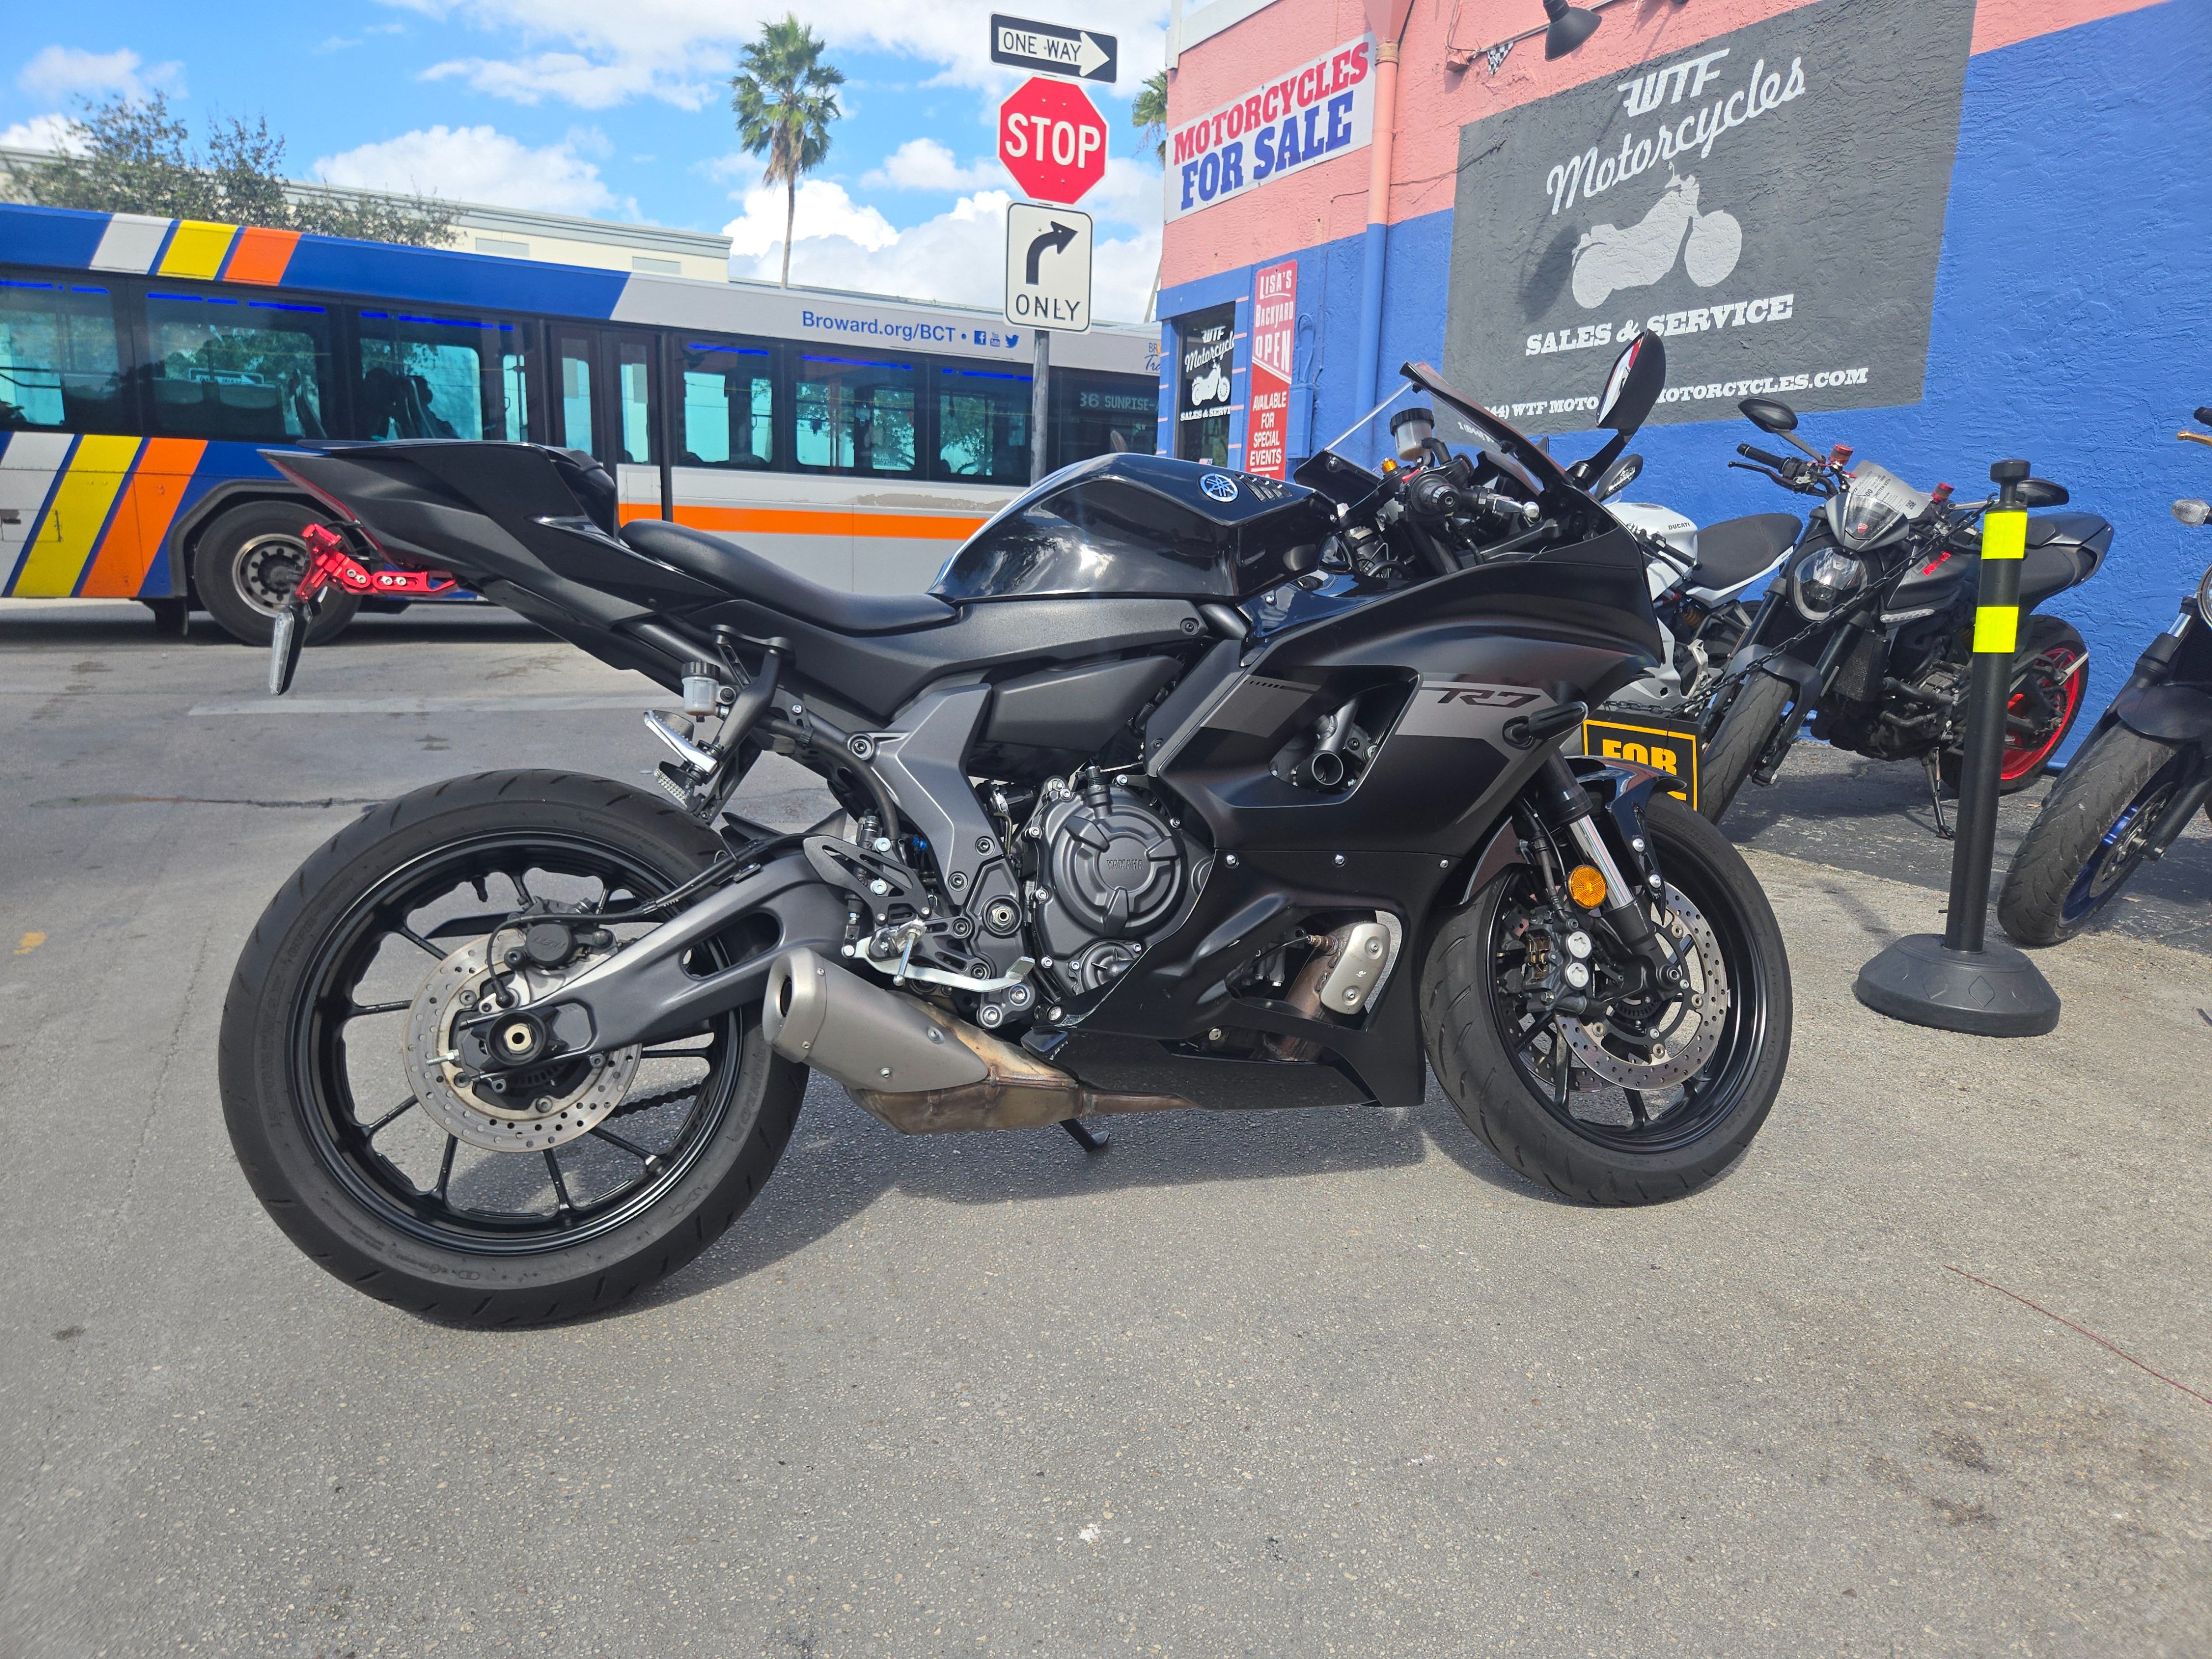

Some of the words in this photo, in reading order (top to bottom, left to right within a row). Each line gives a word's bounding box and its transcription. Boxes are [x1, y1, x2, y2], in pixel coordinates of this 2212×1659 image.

[1003, 32, 1037, 54] ONE
[1047, 39, 1082, 62] WAY
[1618, 47, 1730, 118] WTF
[1173, 41, 1369, 166] MOTORCYCLES
[1005, 112, 1102, 168] STOP
[1546, 56, 1806, 216] Motorcycles
[1181, 141, 1244, 211] FOR
[1253, 90, 1354, 180] SALE
[1259, 269, 1292, 300] LISA'S
[1015, 294, 1081, 321] ONLY
[1255, 301, 1294, 329] BACKYARD
[802, 310, 956, 343] Broward.org/BCT
[1201, 326, 1227, 343] WTF
[1525, 322, 1612, 356] SALES
[1616, 319, 1640, 343] &
[1646, 294, 1794, 337] SERVICE
[1255, 330, 1291, 374] OPEN
[1180, 410, 1202, 421] SALES
[1202, 409, 1209, 418] &
[1253, 392, 1287, 411] AVAILABLE
[1484, 404, 1510, 420] 44)
[1512, 401, 1548, 416] WTF
[1548, 397, 1599, 414] MOTO
[1261, 412, 1275, 429] FOR
[1253, 430, 1280, 448] SPECIAL
[1250, 448, 1282, 466] EVENTS
[1668, 522, 1690, 530] DUCATI
[1438, 686, 1540, 708] R7
[1106, 858, 1144, 871] YAMAHA
